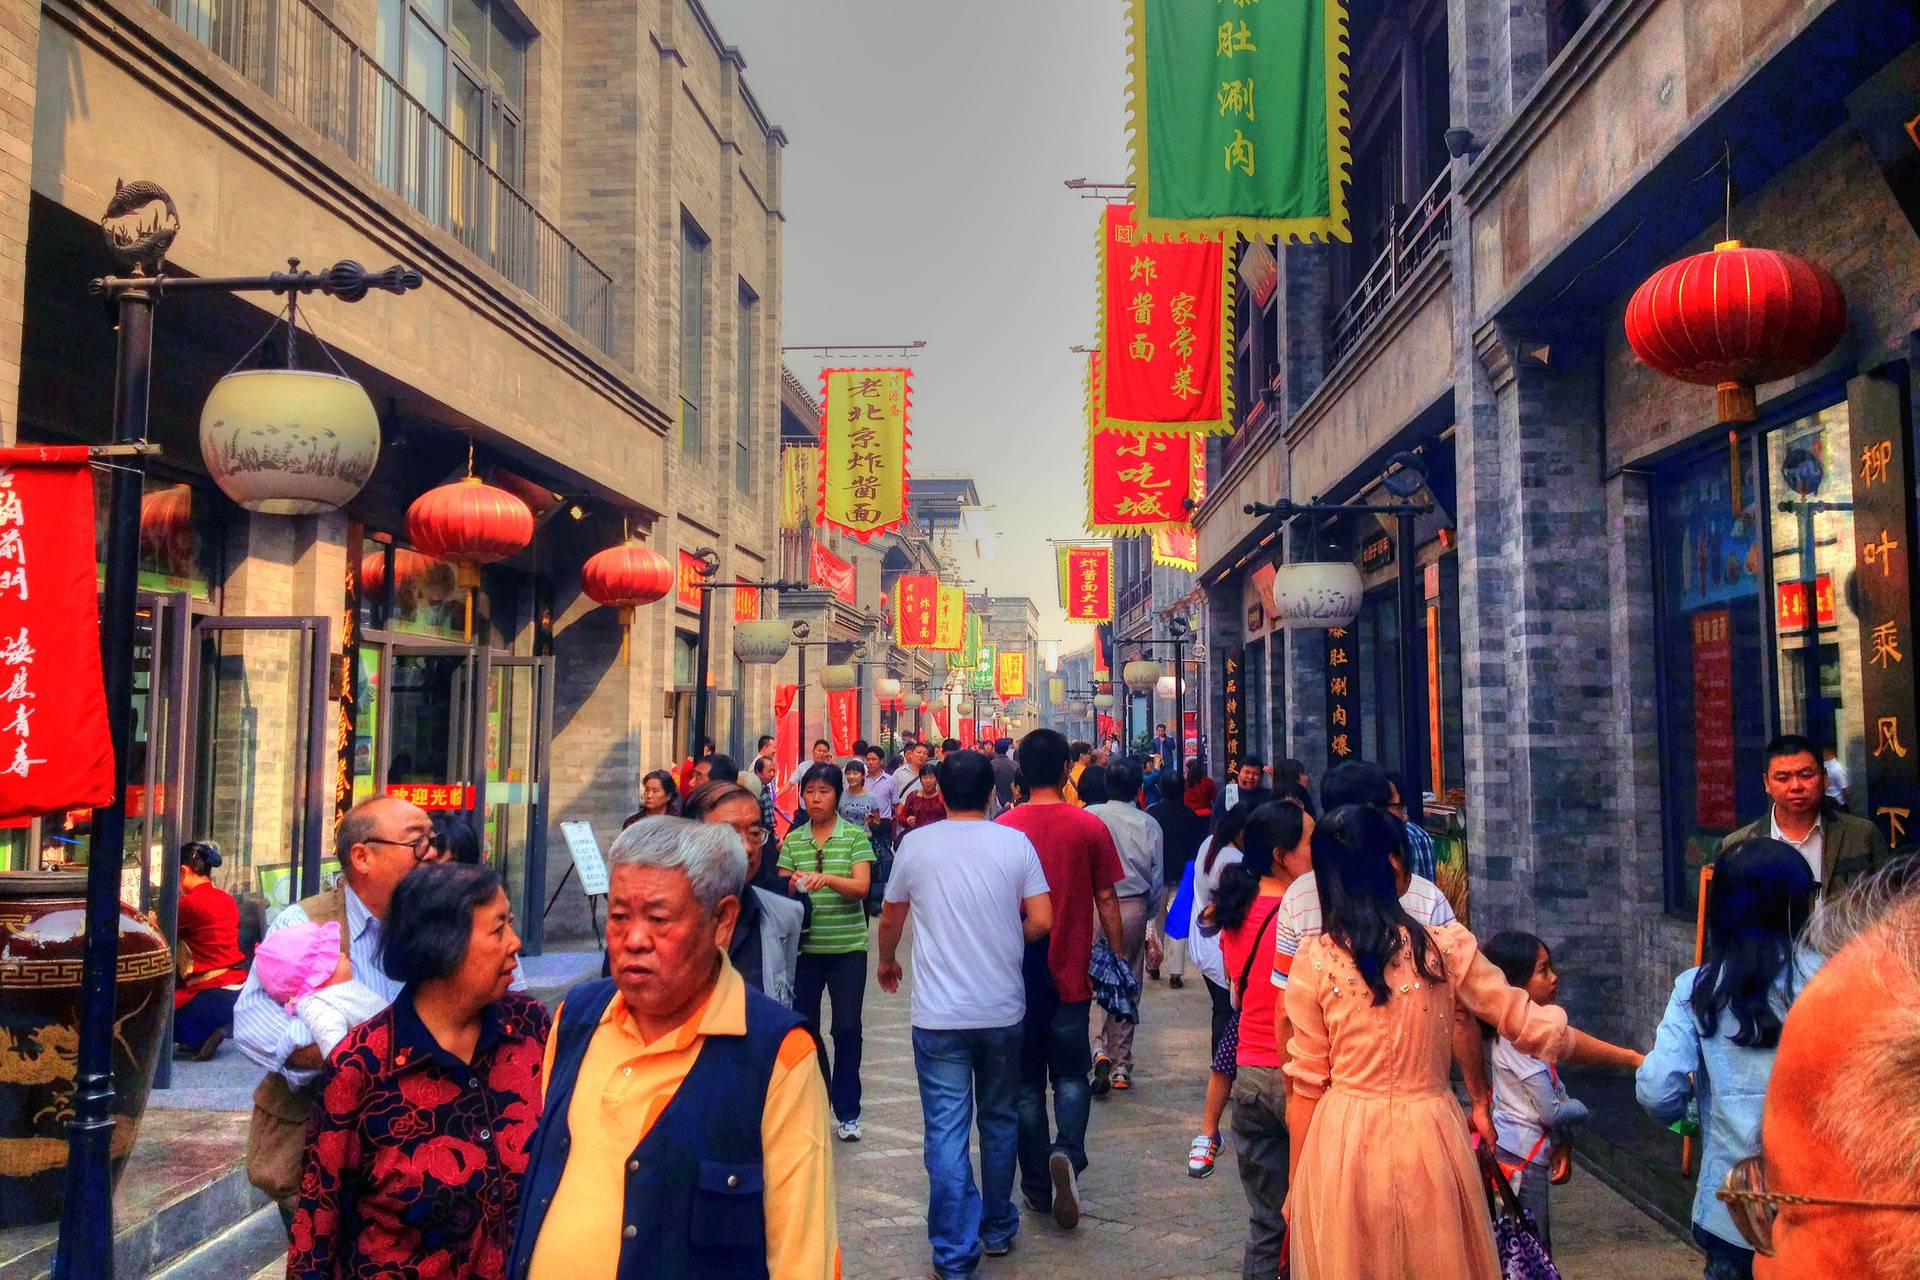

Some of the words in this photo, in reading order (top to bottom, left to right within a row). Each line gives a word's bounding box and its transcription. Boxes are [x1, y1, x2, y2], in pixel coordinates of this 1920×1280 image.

[1216, 0, 1259, 177] 肚涮肉
[1169, 291, 1202, 401] 家常菜
[1114, 433, 1171, 519] 小吃城
[1226, 658, 1240, 784] 食品特色價更
